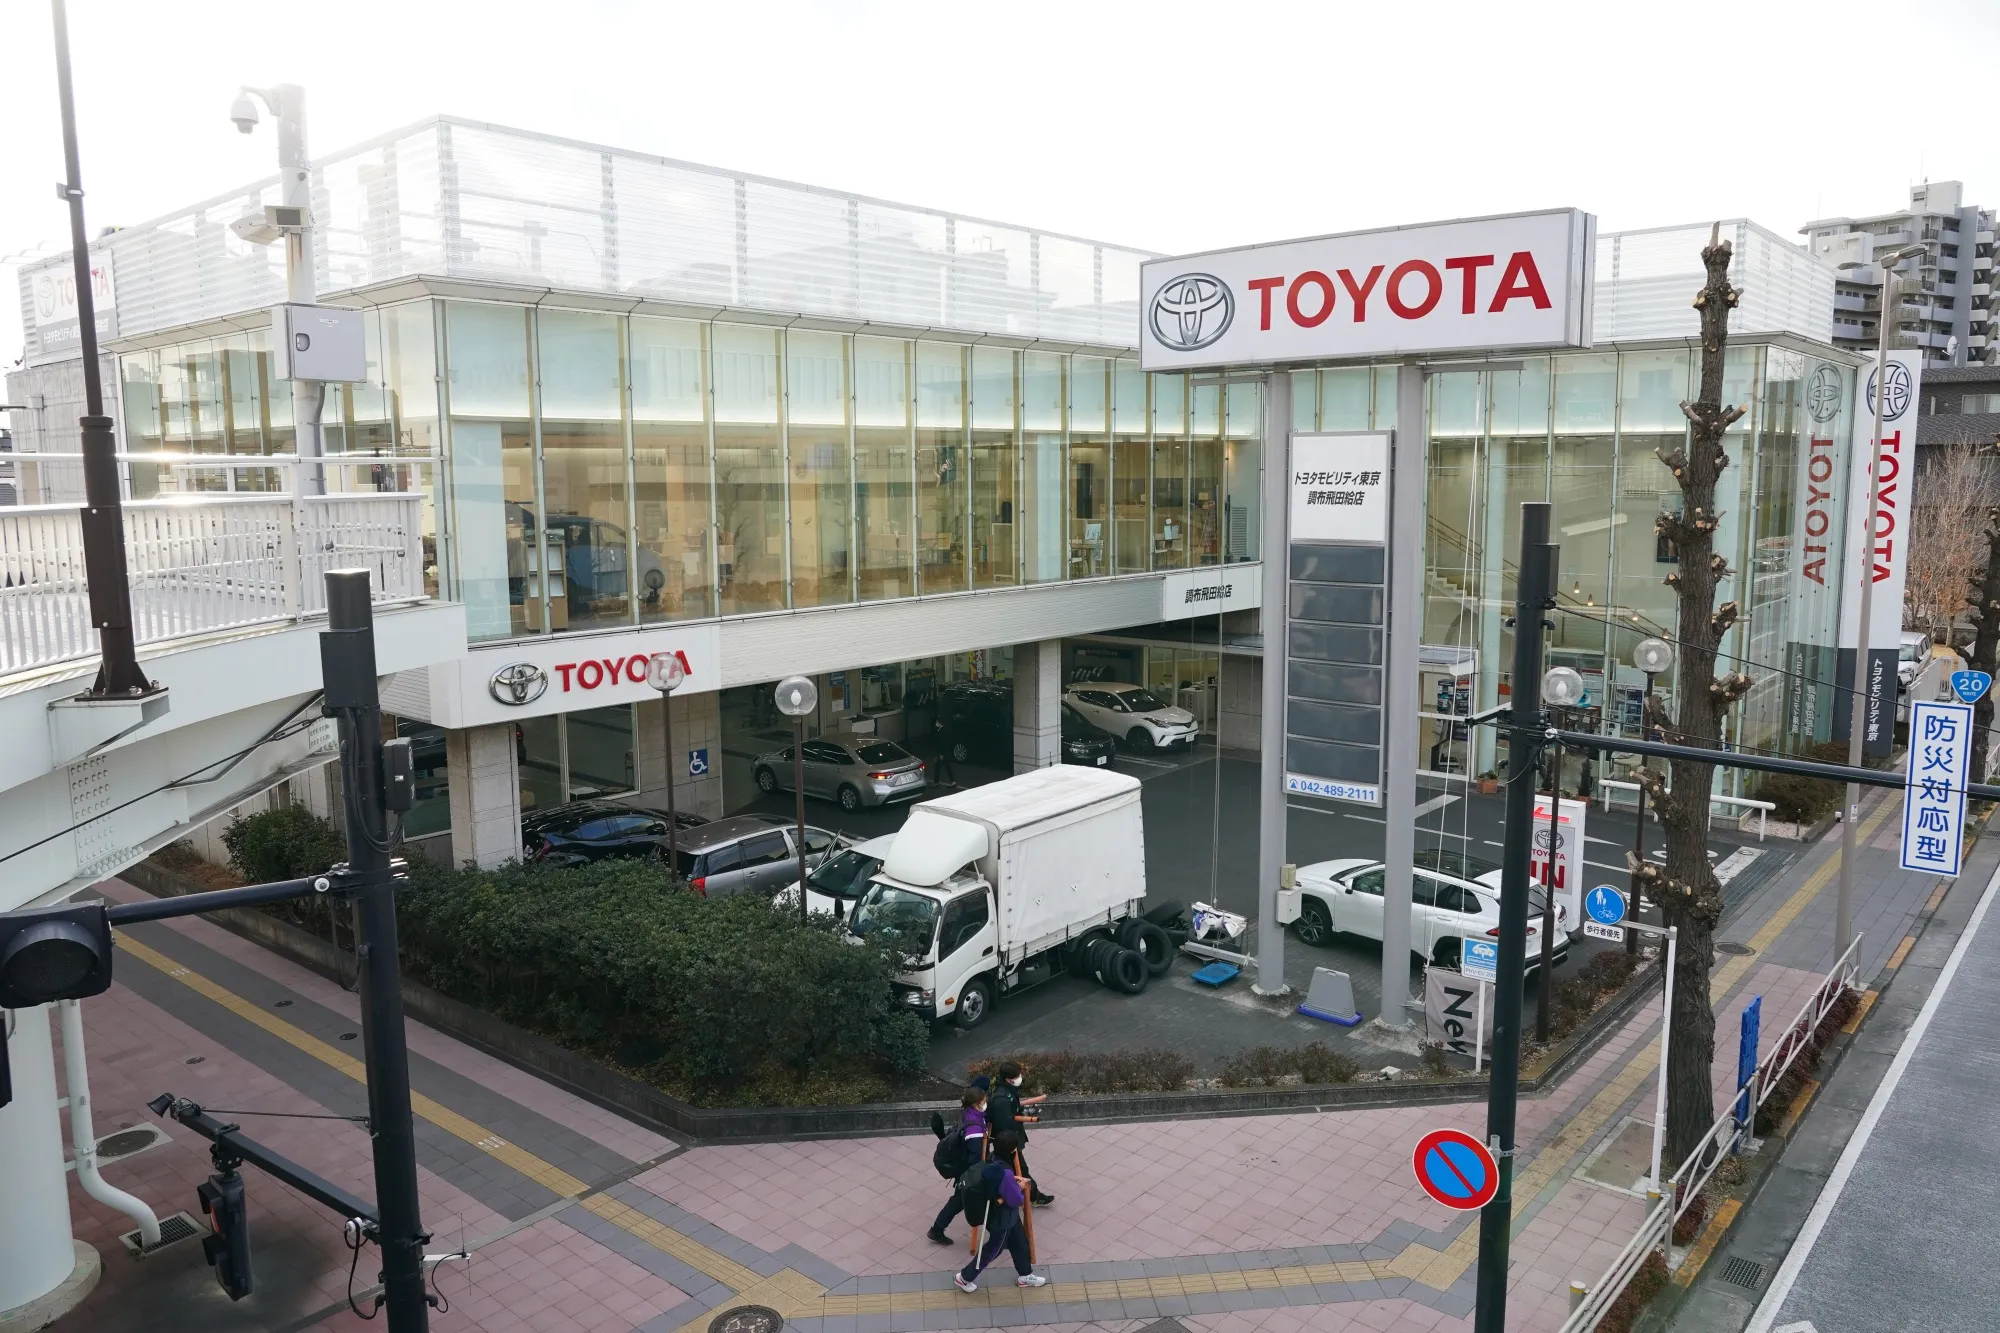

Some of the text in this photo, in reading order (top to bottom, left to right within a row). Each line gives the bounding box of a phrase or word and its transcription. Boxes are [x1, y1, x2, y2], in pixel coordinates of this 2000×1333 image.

[57, 266, 110, 307] TOTA
[1248, 251, 1552, 331] TOYOTA
[1294, 471, 1381, 486] トヨタモビリティ東京
[1307, 490, 1365, 505] 調布飛田給店
[1185, 584, 1232, 603] 調布飛田給店
[555, 650, 692, 692] TOYOTA
[1959, 678, 1983, 691] 20
[1867, 658, 1883, 741] トヨタモビリティ東京
[1300, 780, 1375, 800] 042-489-2111
[1915, 714, 1958, 863] 防災対応型
[1532, 849, 1565, 861] TOYTA
[1530, 860, 1565, 889] IN
[1586, 924, 1620, 939] 歩行者優先
